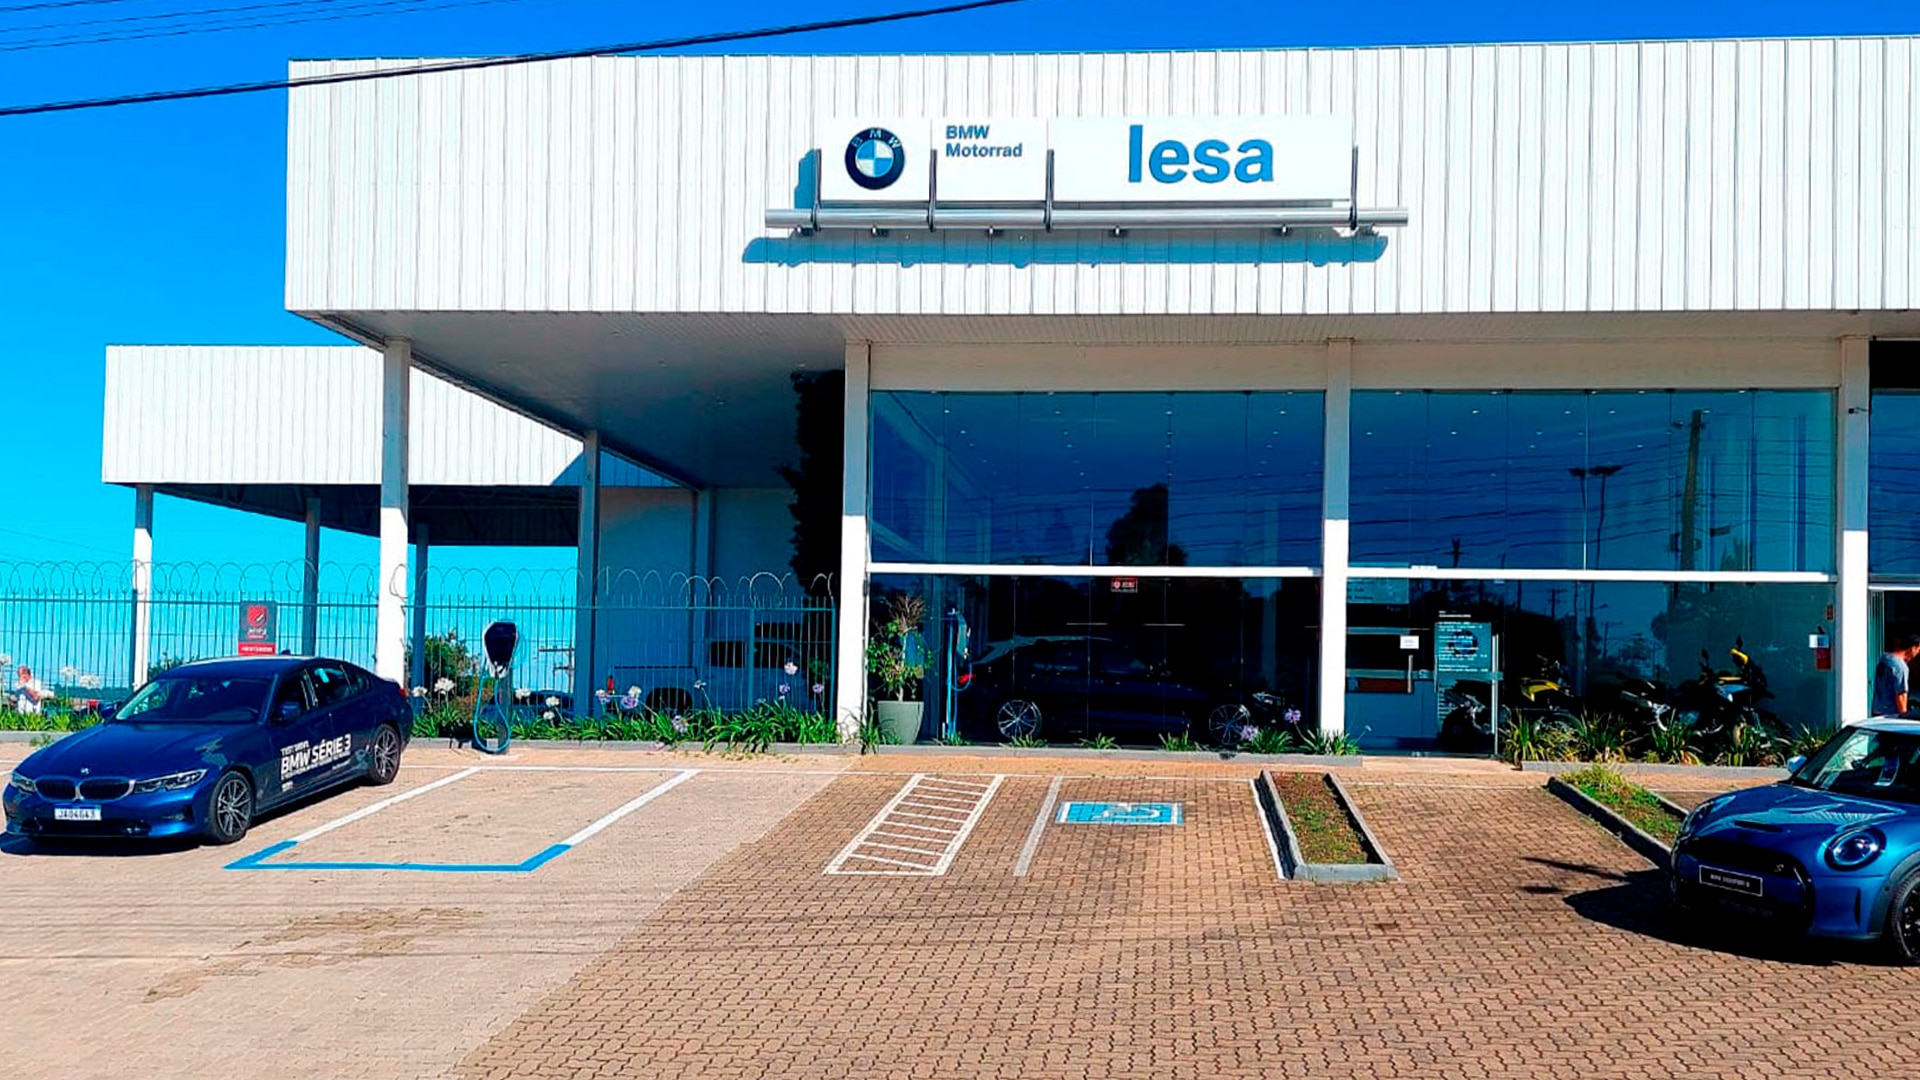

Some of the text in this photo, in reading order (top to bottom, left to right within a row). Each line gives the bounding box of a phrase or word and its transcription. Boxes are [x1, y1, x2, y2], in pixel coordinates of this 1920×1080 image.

[851, 129, 900, 149] BMW
[946, 125, 989, 139] BMW
[946, 142, 1023, 158] Motorrad
[280, 748, 311, 776] BMW
[311, 737, 343, 763] SÉRIE
[344, 733, 352, 751] 3
